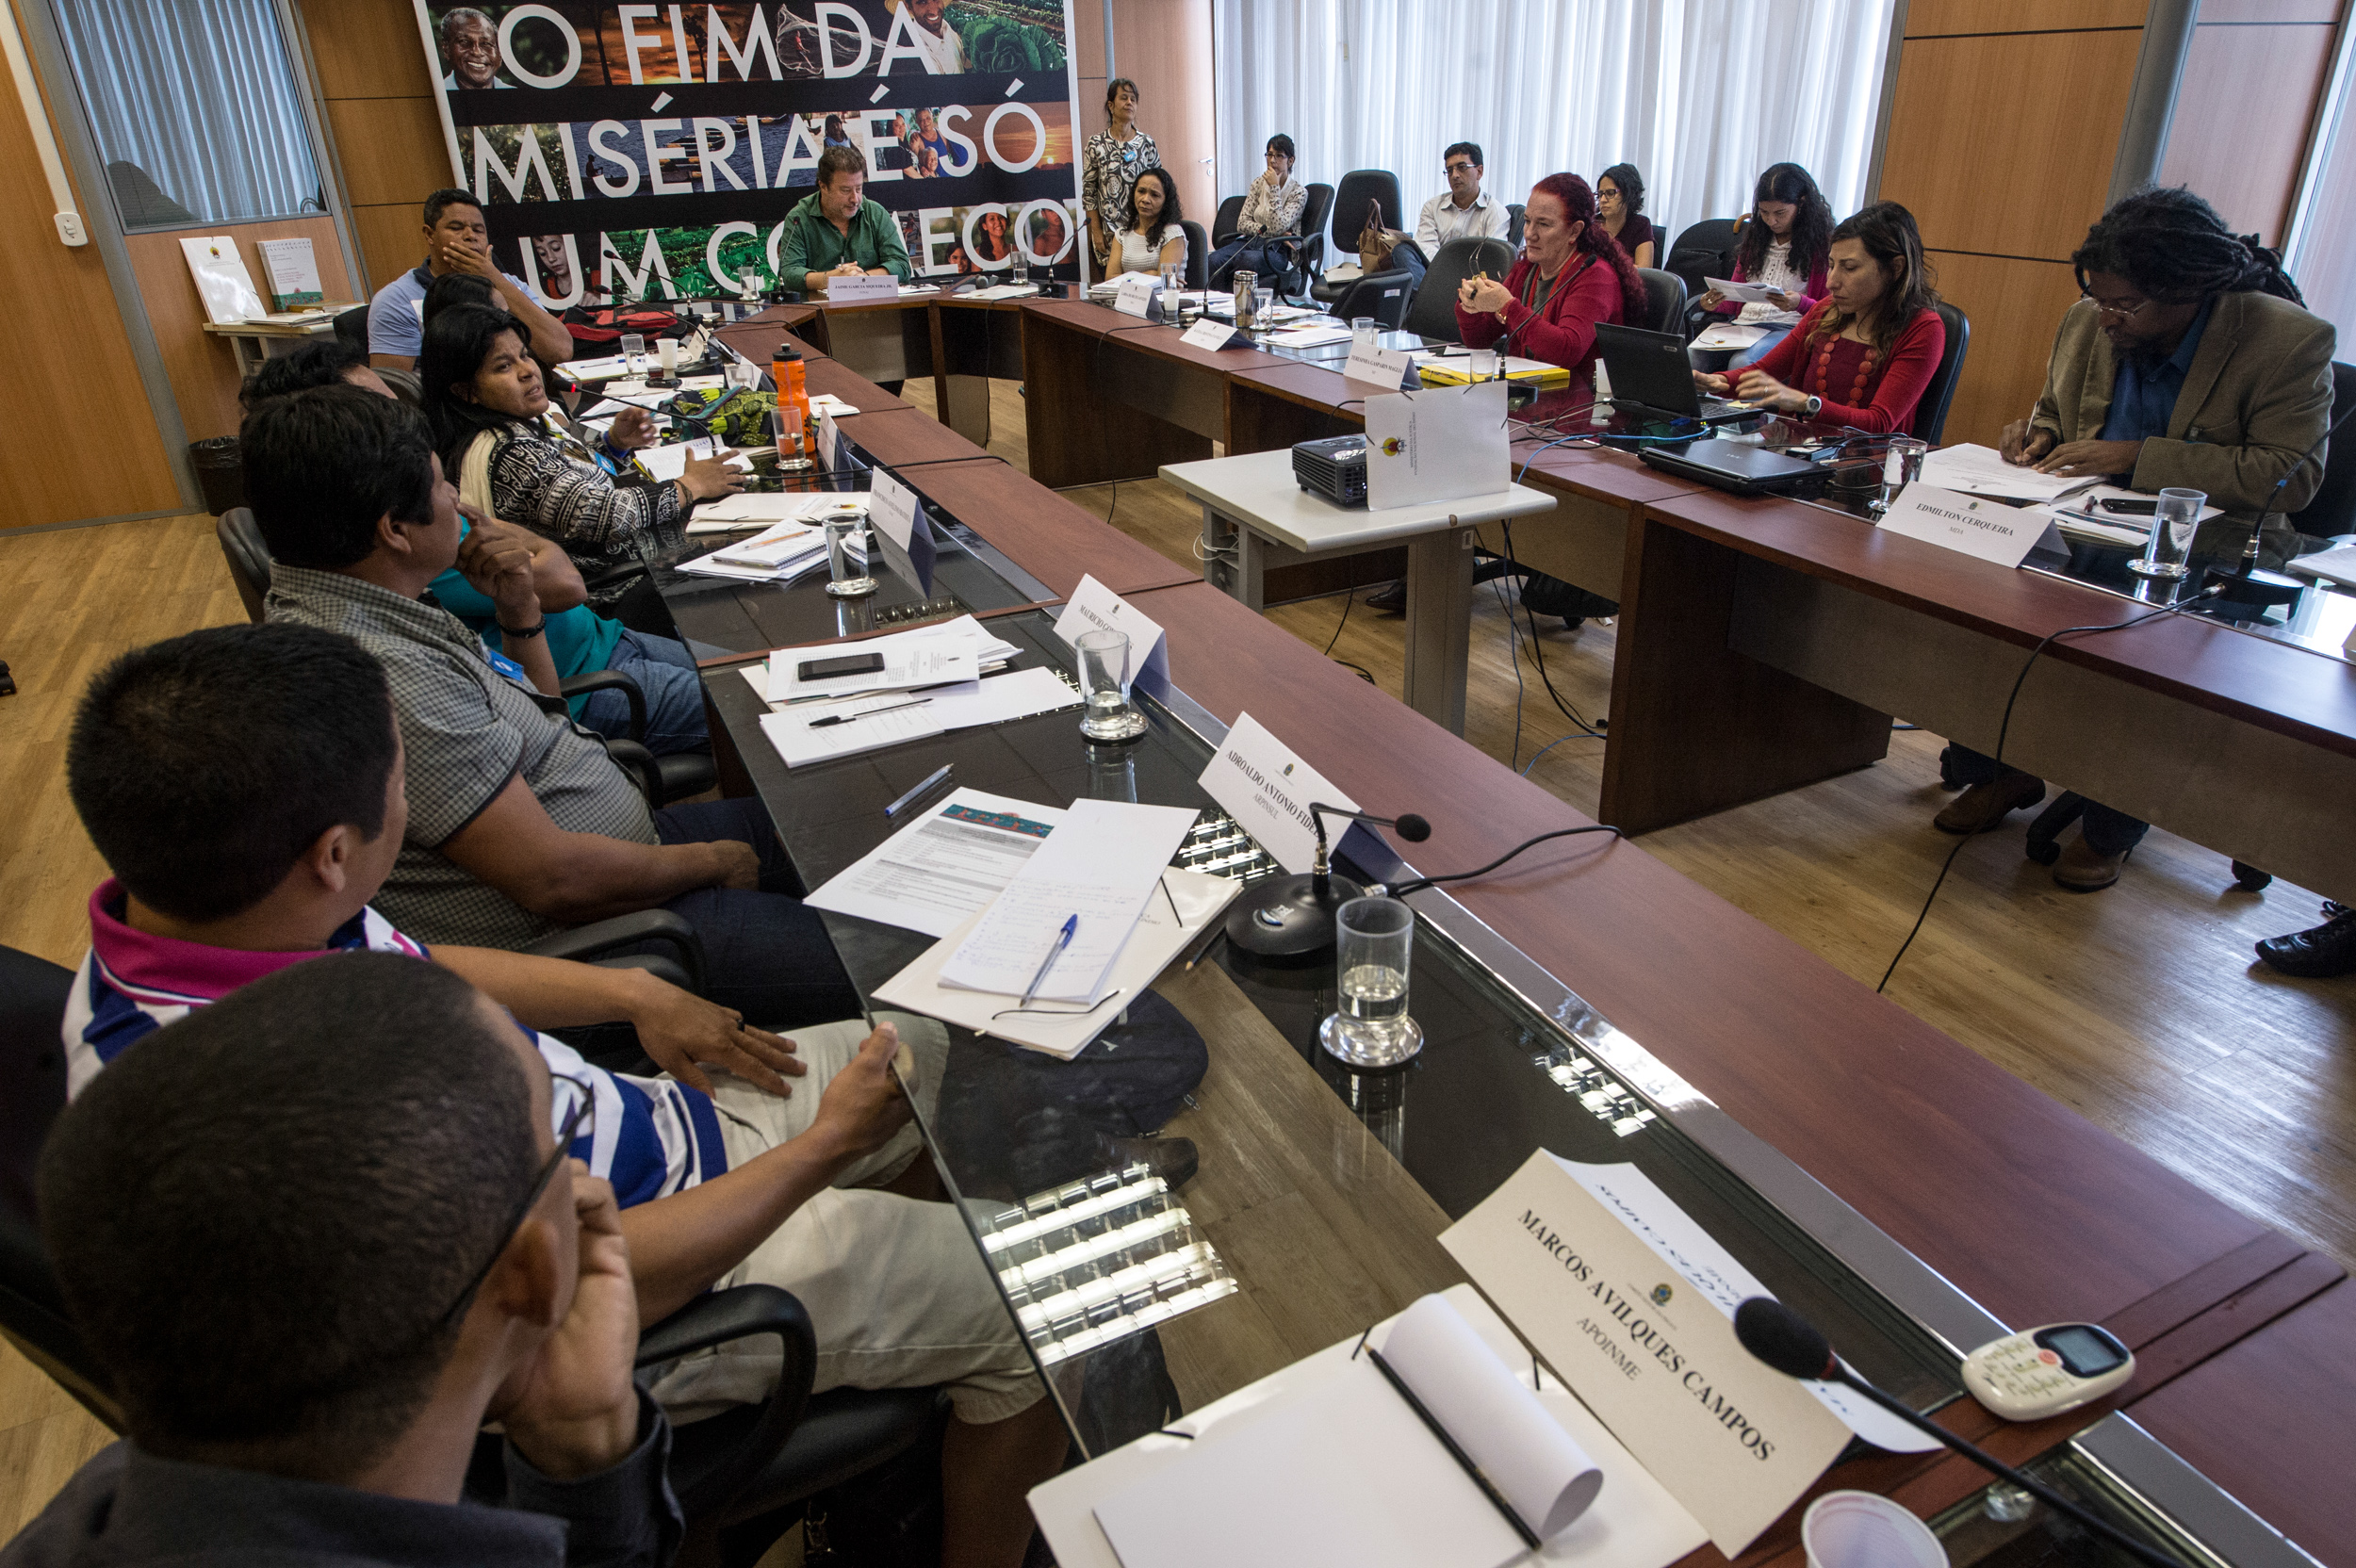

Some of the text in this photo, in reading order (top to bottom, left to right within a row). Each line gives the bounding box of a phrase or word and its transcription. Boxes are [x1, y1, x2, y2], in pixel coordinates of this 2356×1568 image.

[498, 1, 939, 90] O FIM DA
[473, 77, 1046, 205] MISÉRIA É SÓ
[518, 198, 1074, 311] UM CEÇO
[1916, 502, 2014, 536] EDMILTON CERQUEIRA
[1948, 526, 1964, 535] MDA
[1079, 604, 1104, 629] MAURICIO
[1225, 749, 1265, 787] ADROALDO
[1262, 780, 1299, 816] ANTONIO
[1252, 792, 1279, 821] ARPINSUL
[1517, 1209, 1594, 1283] MARCOS
[1587, 1281, 1686, 1373] AVILQUES
[1682, 1369, 1775, 1462] CAMPOS
[1576, 1316, 1642, 1381] APOINME
